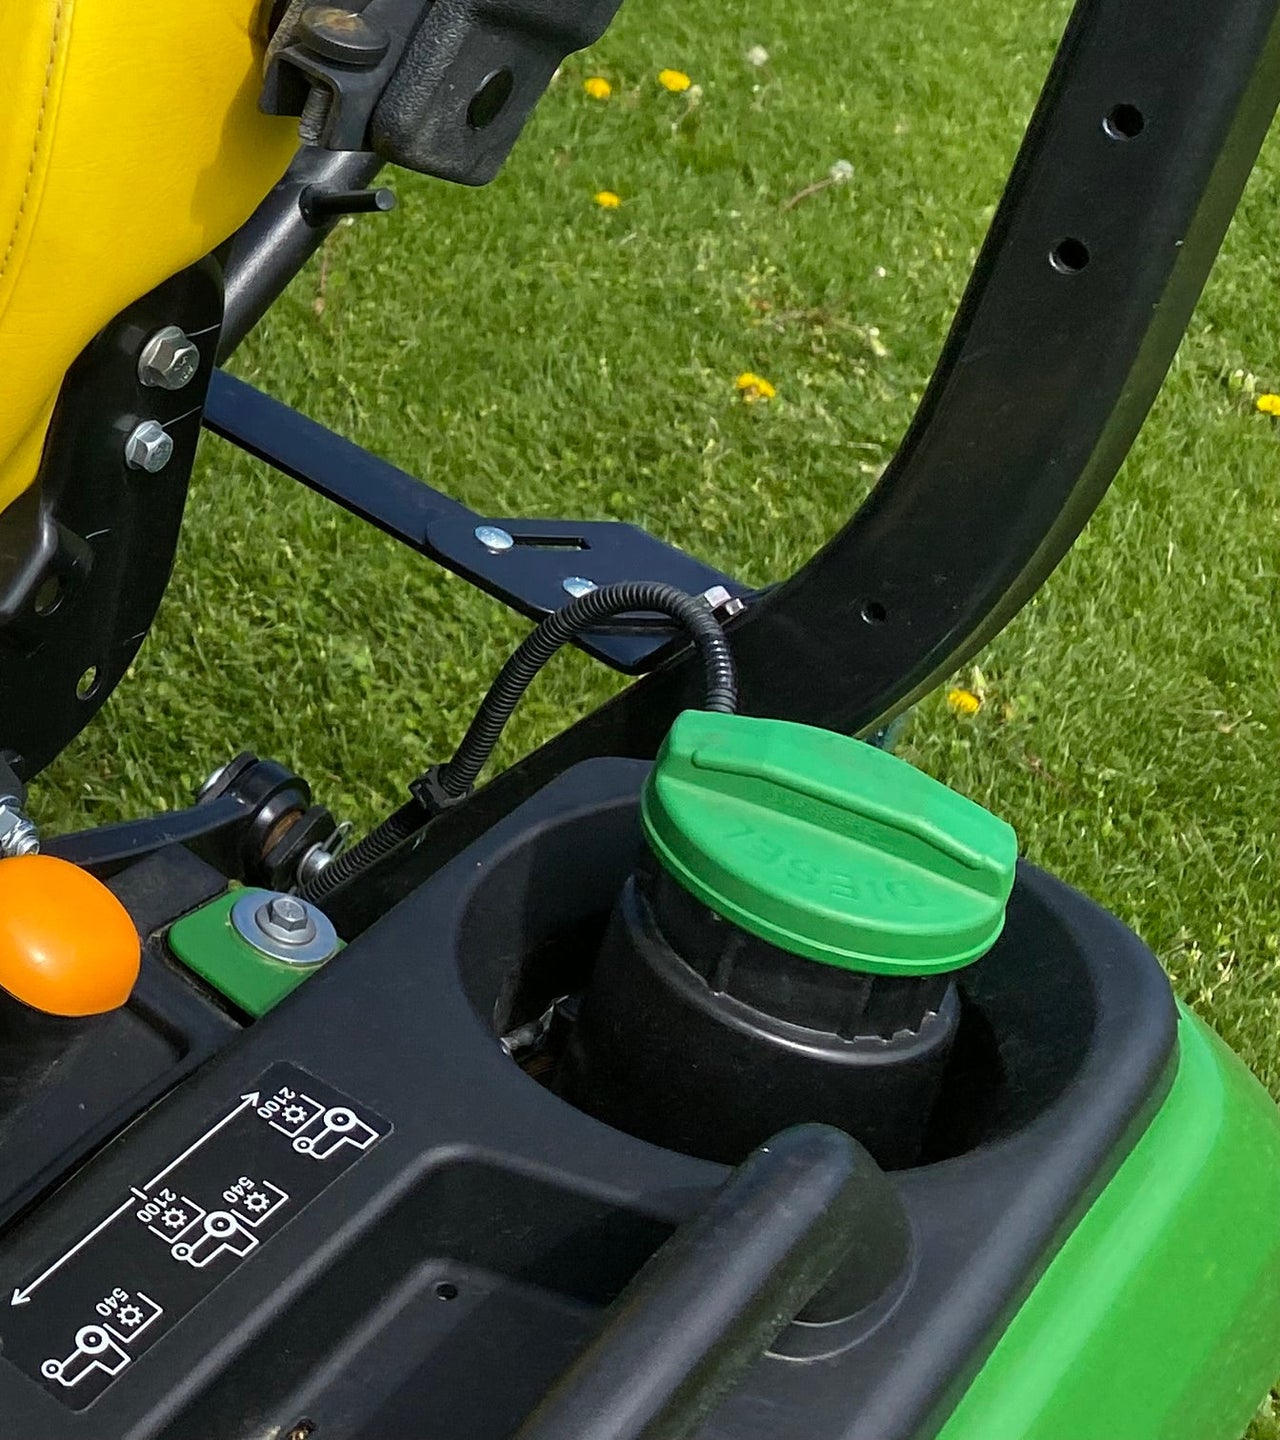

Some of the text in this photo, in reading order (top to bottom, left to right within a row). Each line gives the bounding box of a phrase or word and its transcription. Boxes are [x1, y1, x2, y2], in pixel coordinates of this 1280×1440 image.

[257, 1086, 296, 1119] 2100
[136, 1187, 177, 1223] 2100
[222, 1176, 256, 1203] 540
[95, 1287, 129, 1317] 540
